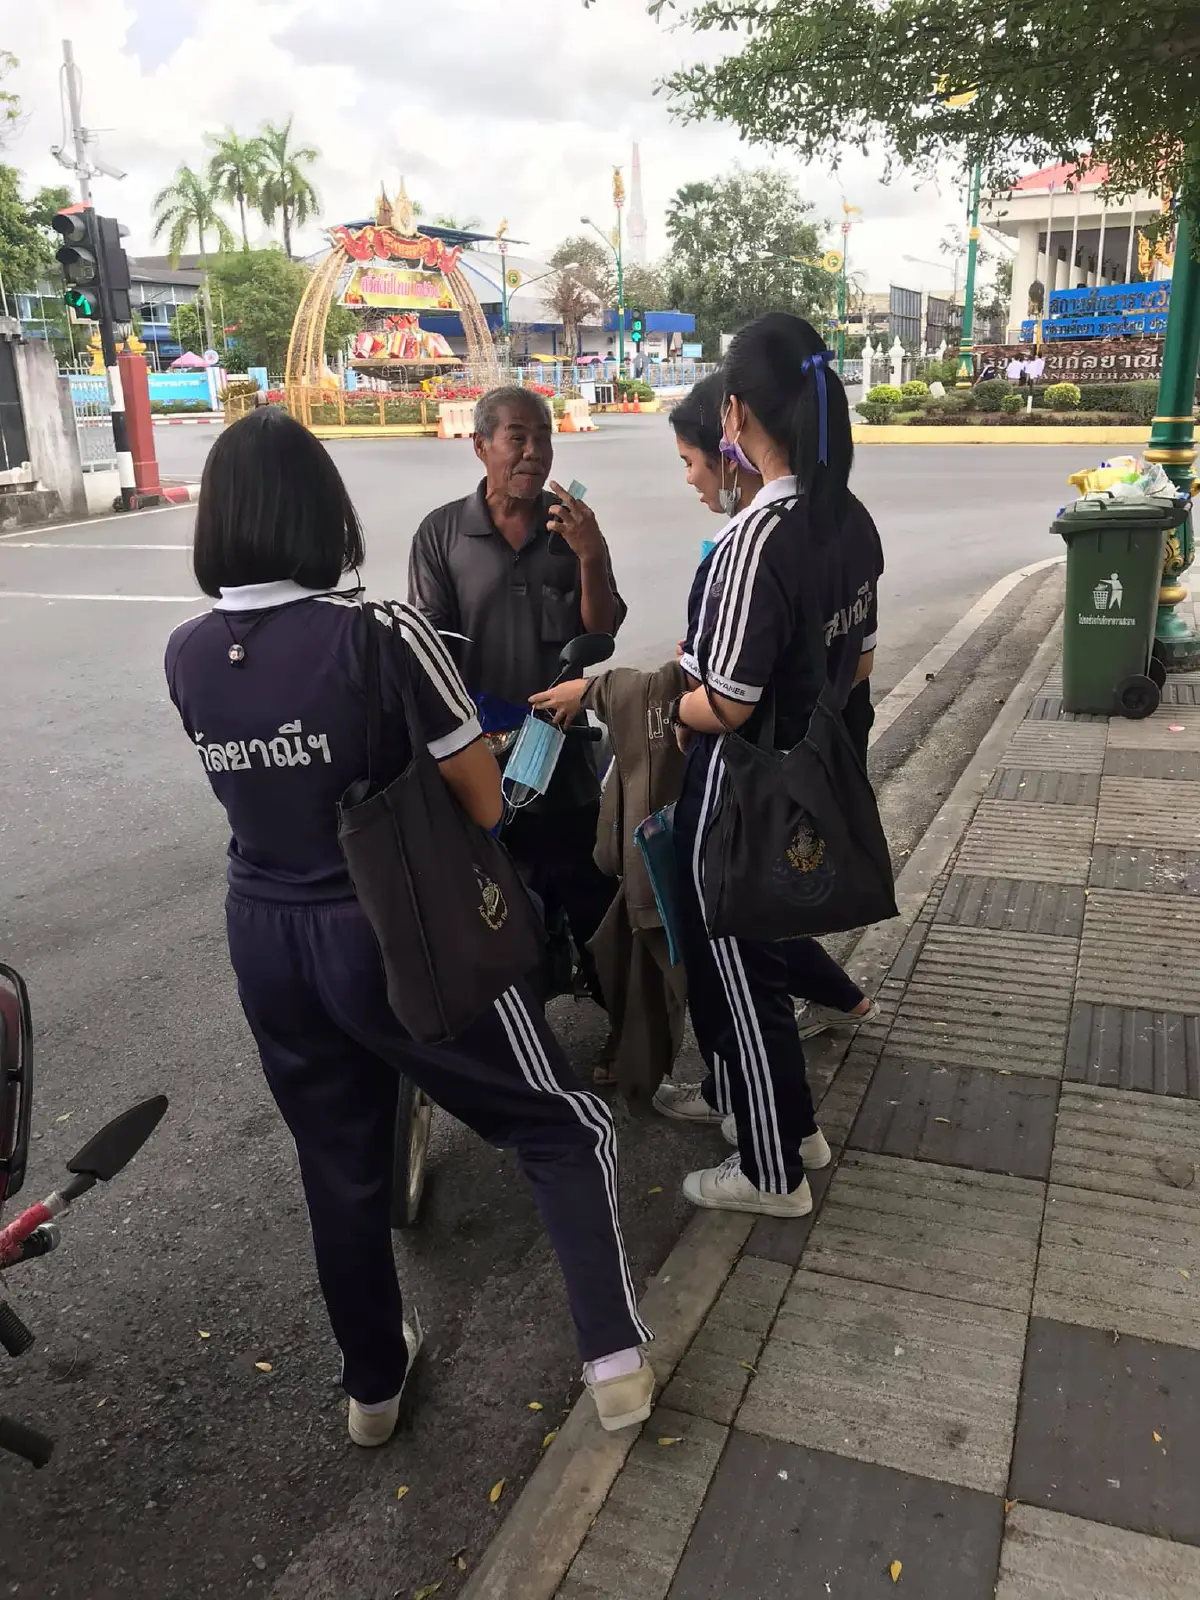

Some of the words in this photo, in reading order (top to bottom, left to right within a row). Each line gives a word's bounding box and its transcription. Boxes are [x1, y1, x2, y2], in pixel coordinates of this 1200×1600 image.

[1049, 284, 1170, 314] สถานศึกษารางวั
[1149, 317, 1168, 331] ประ
